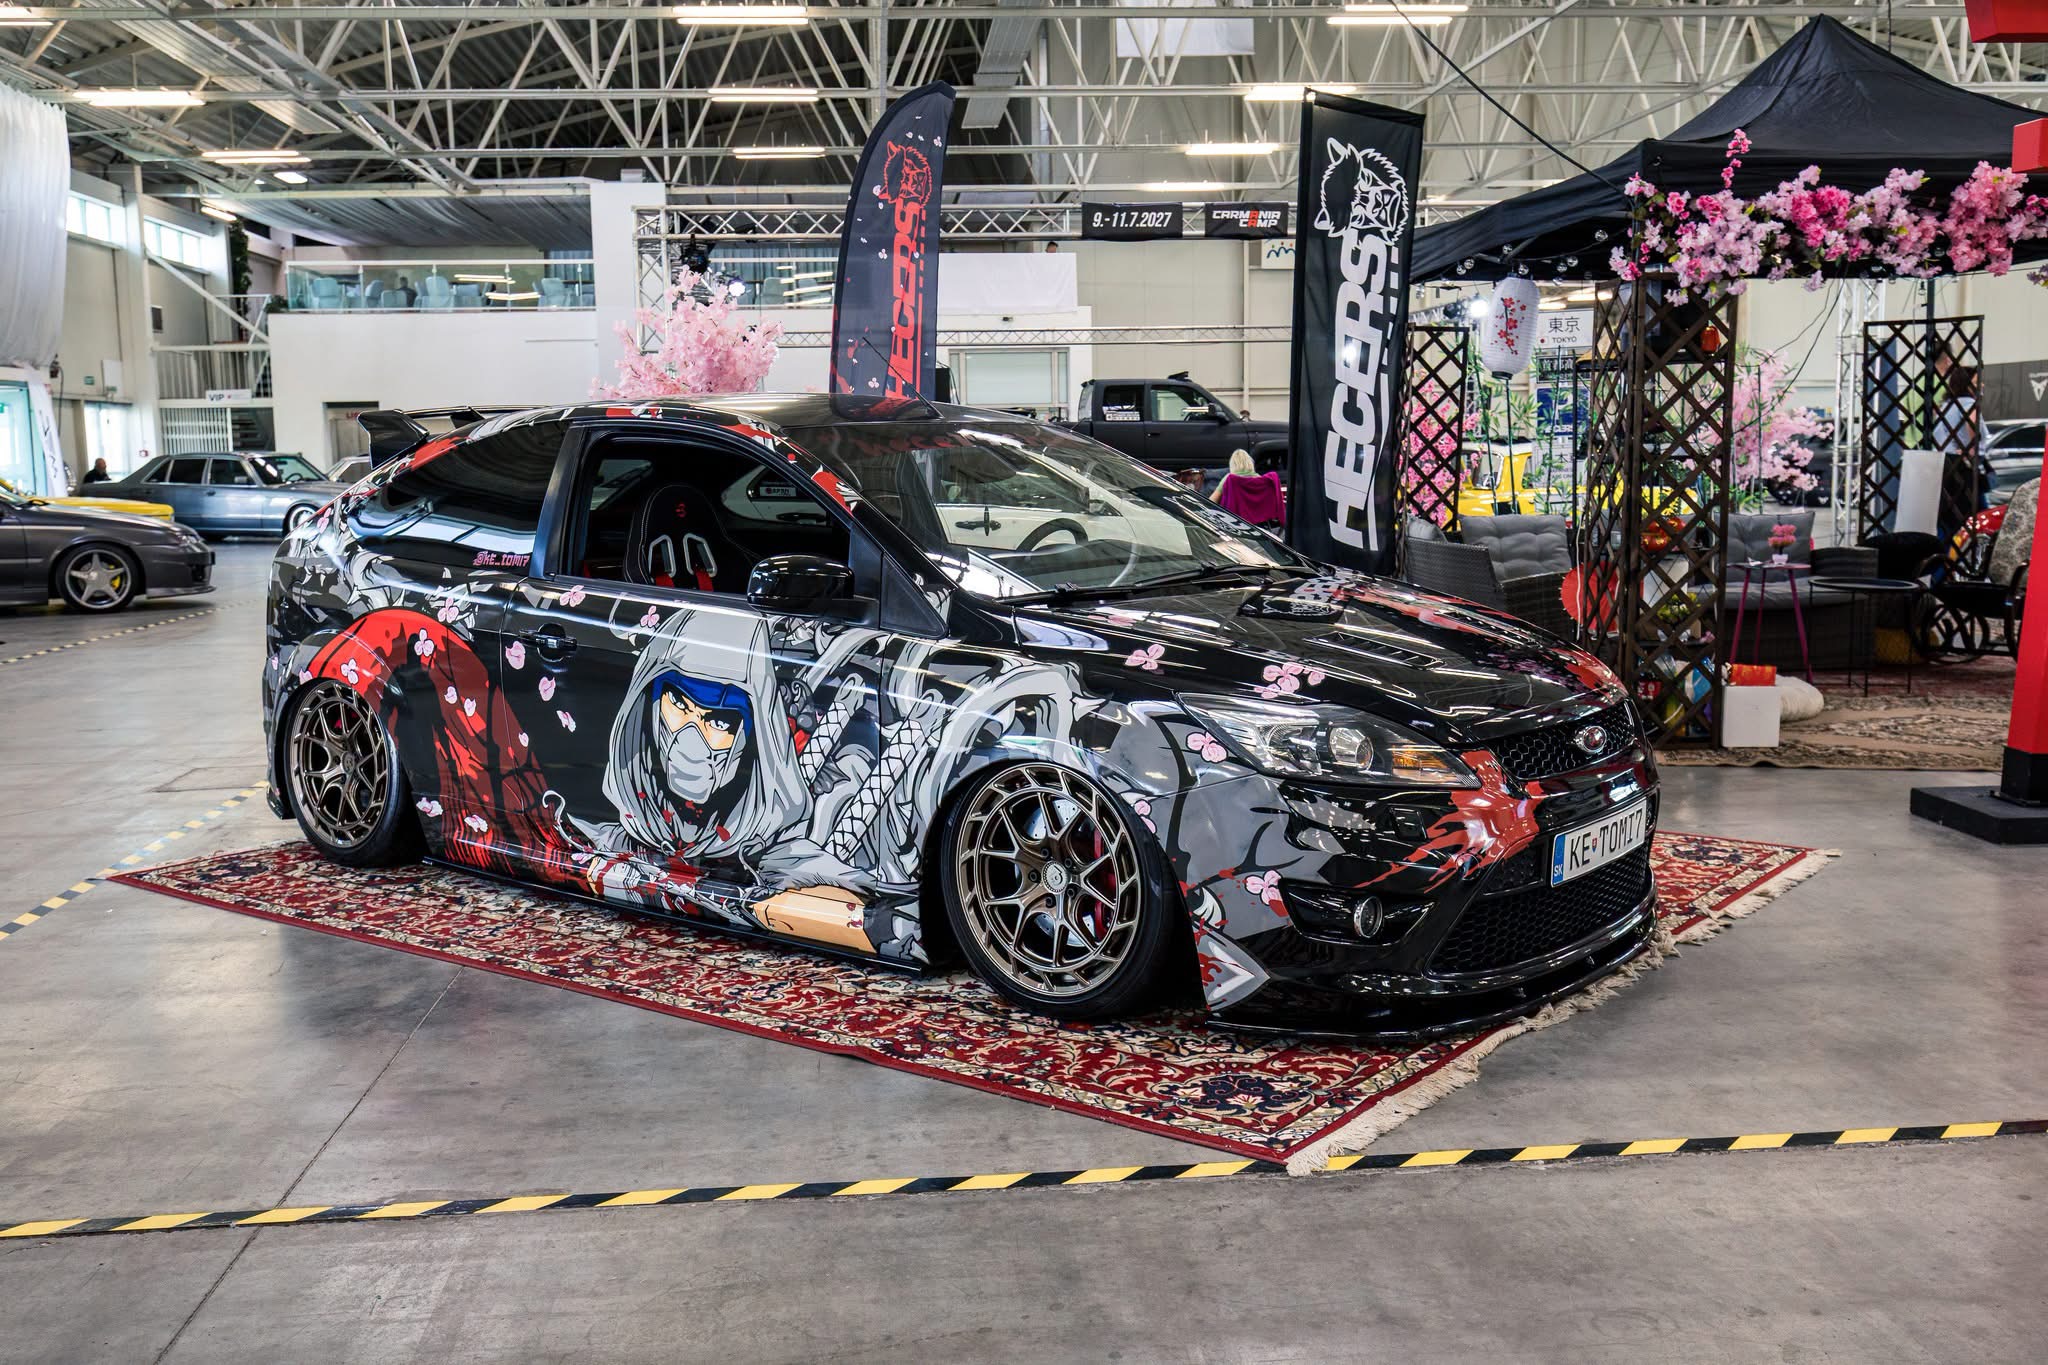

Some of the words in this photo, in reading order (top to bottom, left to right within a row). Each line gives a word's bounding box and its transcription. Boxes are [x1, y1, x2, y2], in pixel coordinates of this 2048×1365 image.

[1212, 210, 1281, 220] CARMANIA
[1239, 219, 1278, 228] CAMP
[1548, 316, 1581, 333] 東京
[1552, 336, 1577, 344] TOKYO
[1324, 226, 1388, 549] HECERS
[208, 393, 225, 402] VIP
[1569, 831, 1592, 871] KE
[1599, 808, 1643, 857] TOMI7
[1553, 863, 1564, 877] SK
